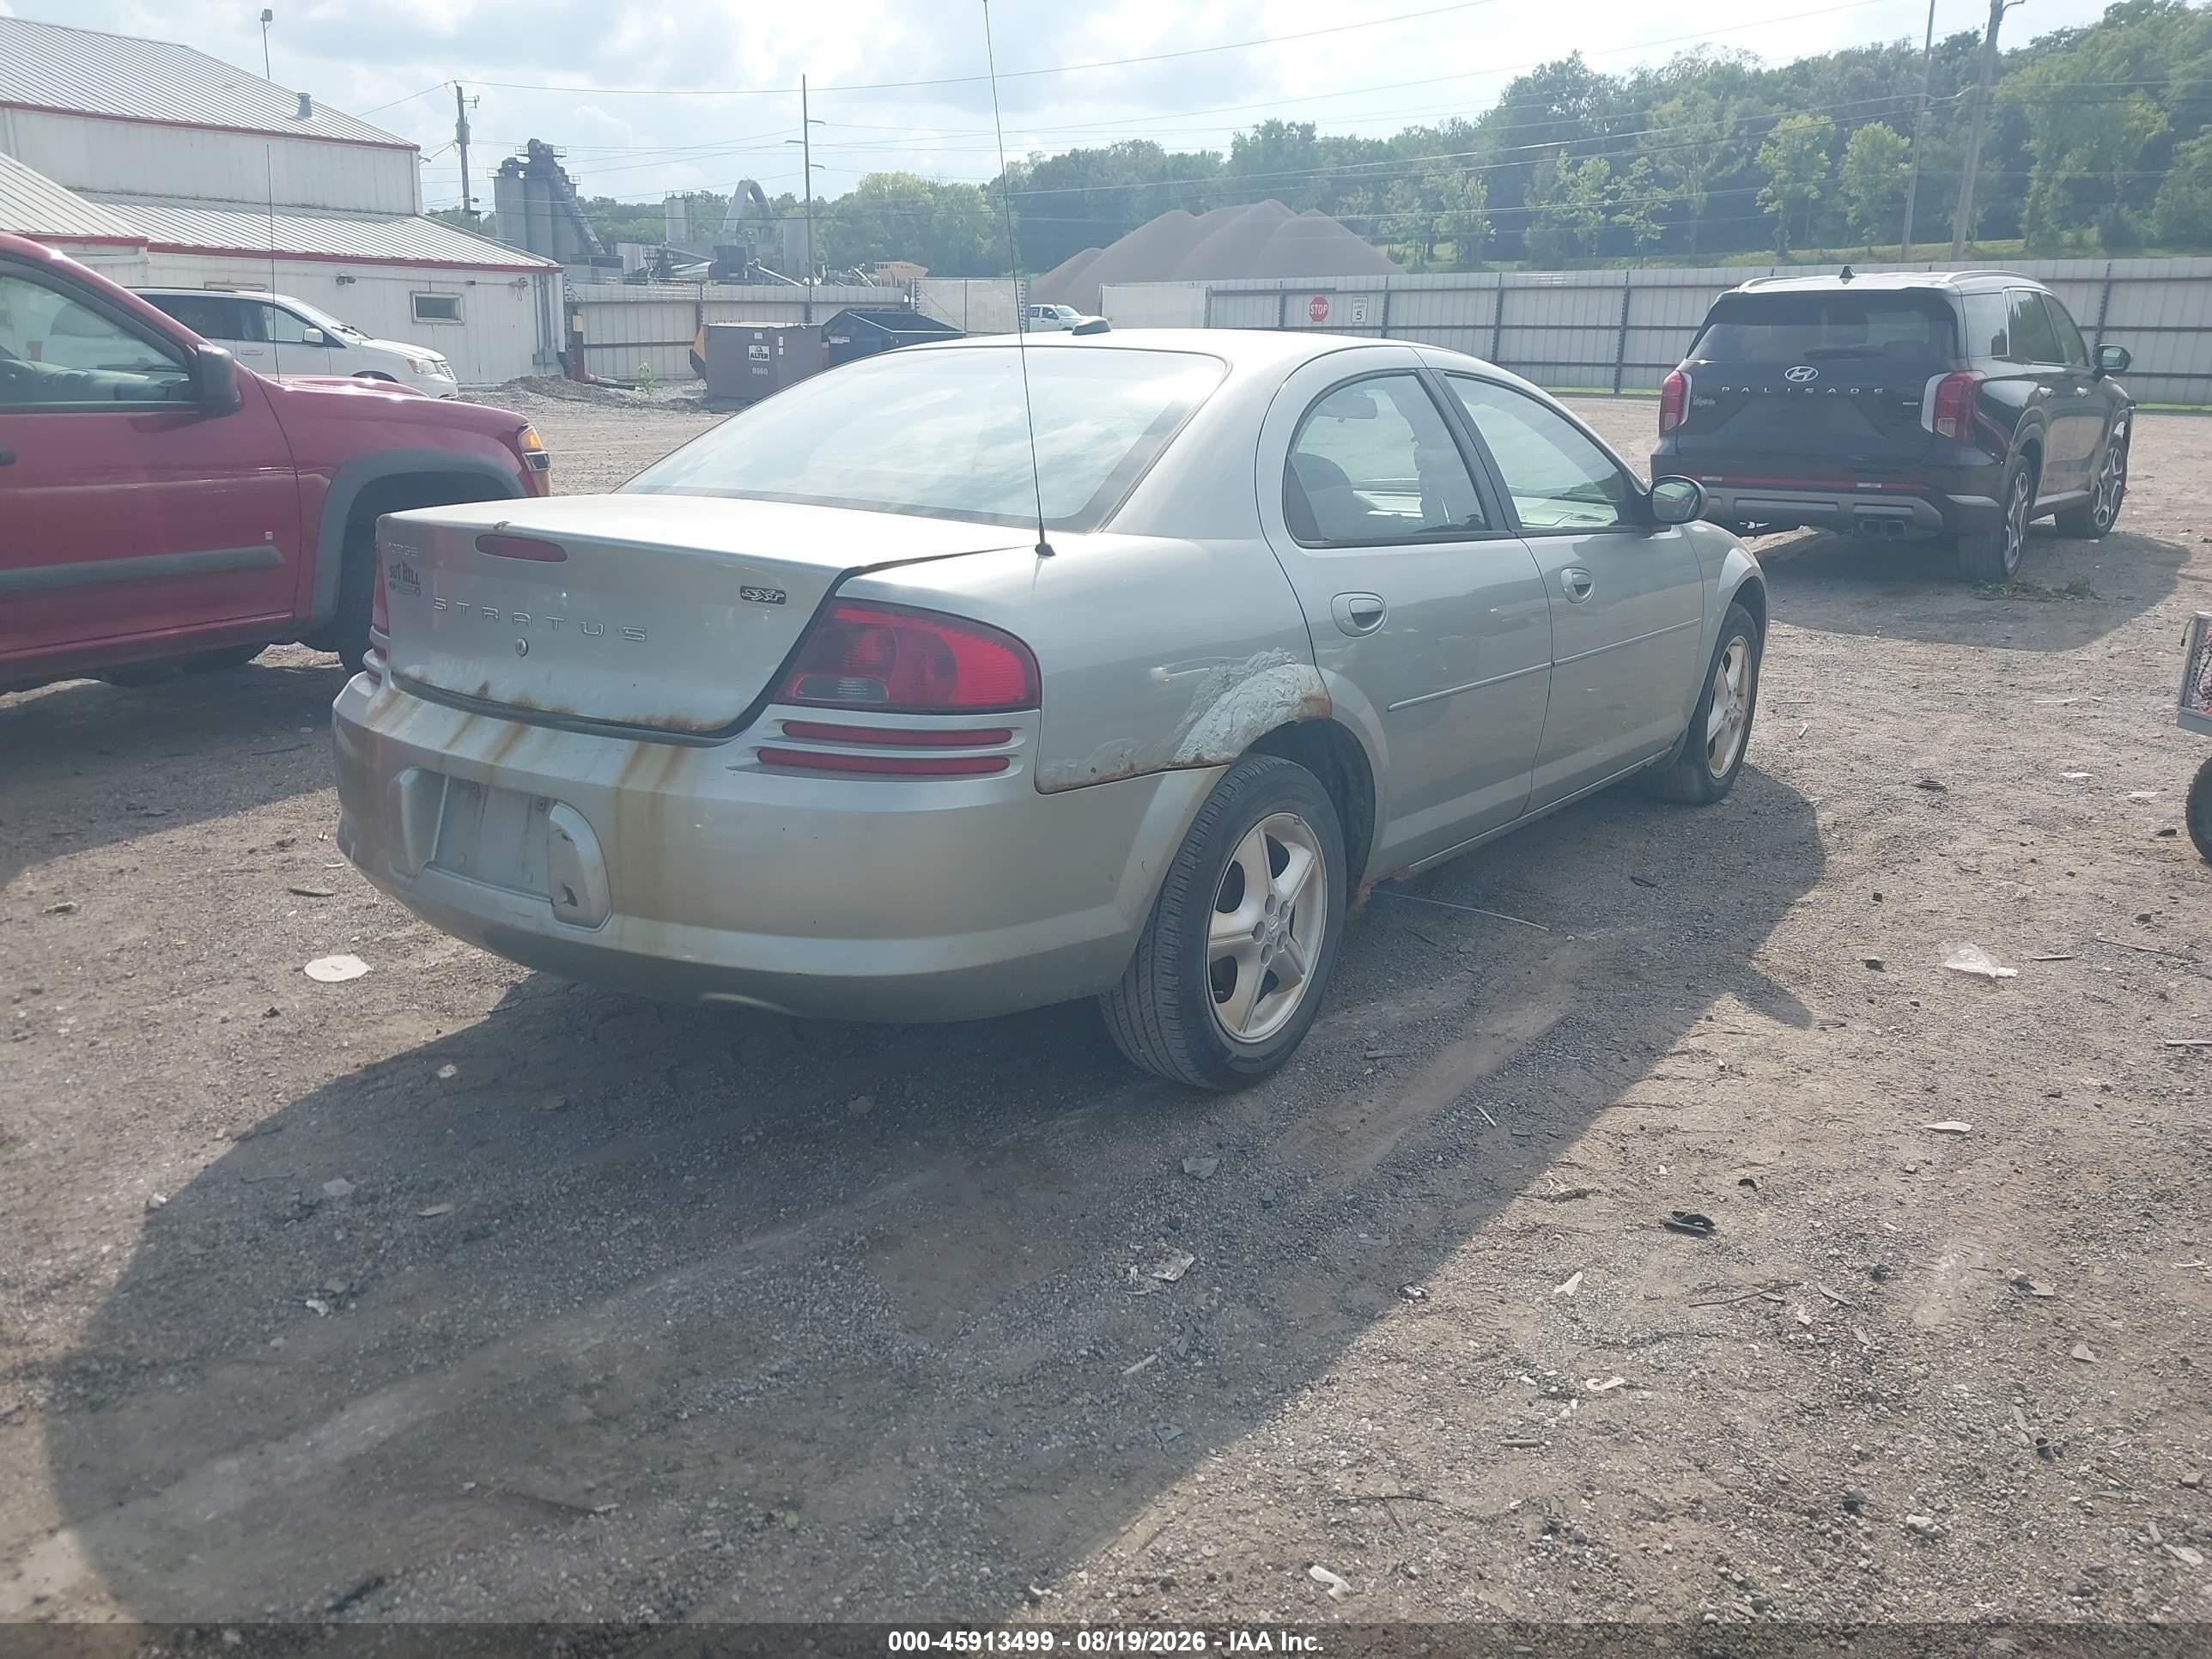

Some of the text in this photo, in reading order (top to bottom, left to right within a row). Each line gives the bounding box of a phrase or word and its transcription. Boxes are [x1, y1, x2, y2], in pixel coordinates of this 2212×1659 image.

[1310, 304, 1328, 315] STOP
[1356, 310, 1363, 320] 5
[1721, 386, 1884, 394] PALISADE
[741, 588, 785, 601] SXT
[433, 597, 647, 641] STRATUS
